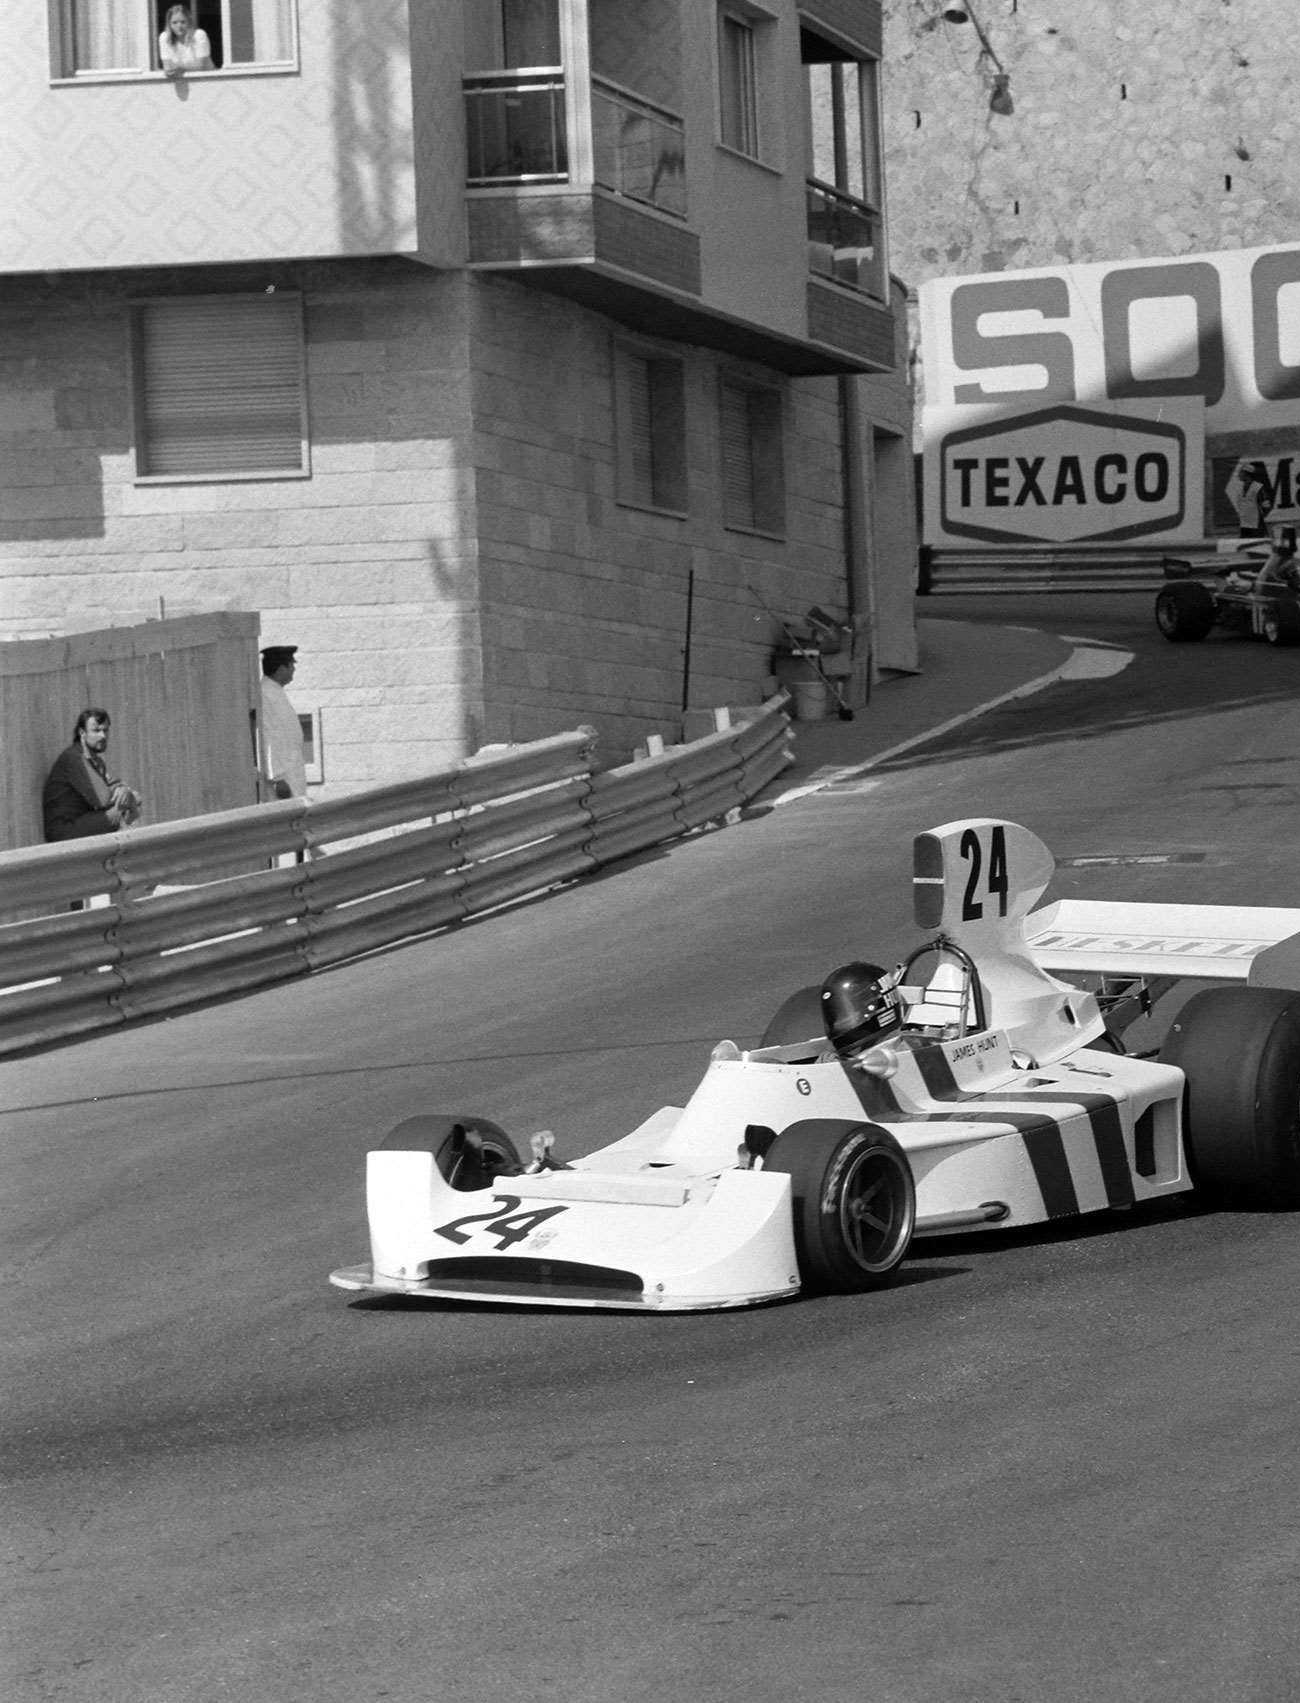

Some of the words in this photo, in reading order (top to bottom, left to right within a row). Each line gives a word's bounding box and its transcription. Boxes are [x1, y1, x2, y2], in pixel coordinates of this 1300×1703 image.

[953, 452, 1169, 507] TEXACO
[960, 826, 1008, 921] 24
[953, 1043, 976, 1063] JAMES
[977, 1034, 999, 1053] HUNT
[433, 1195, 571, 1251] 24
